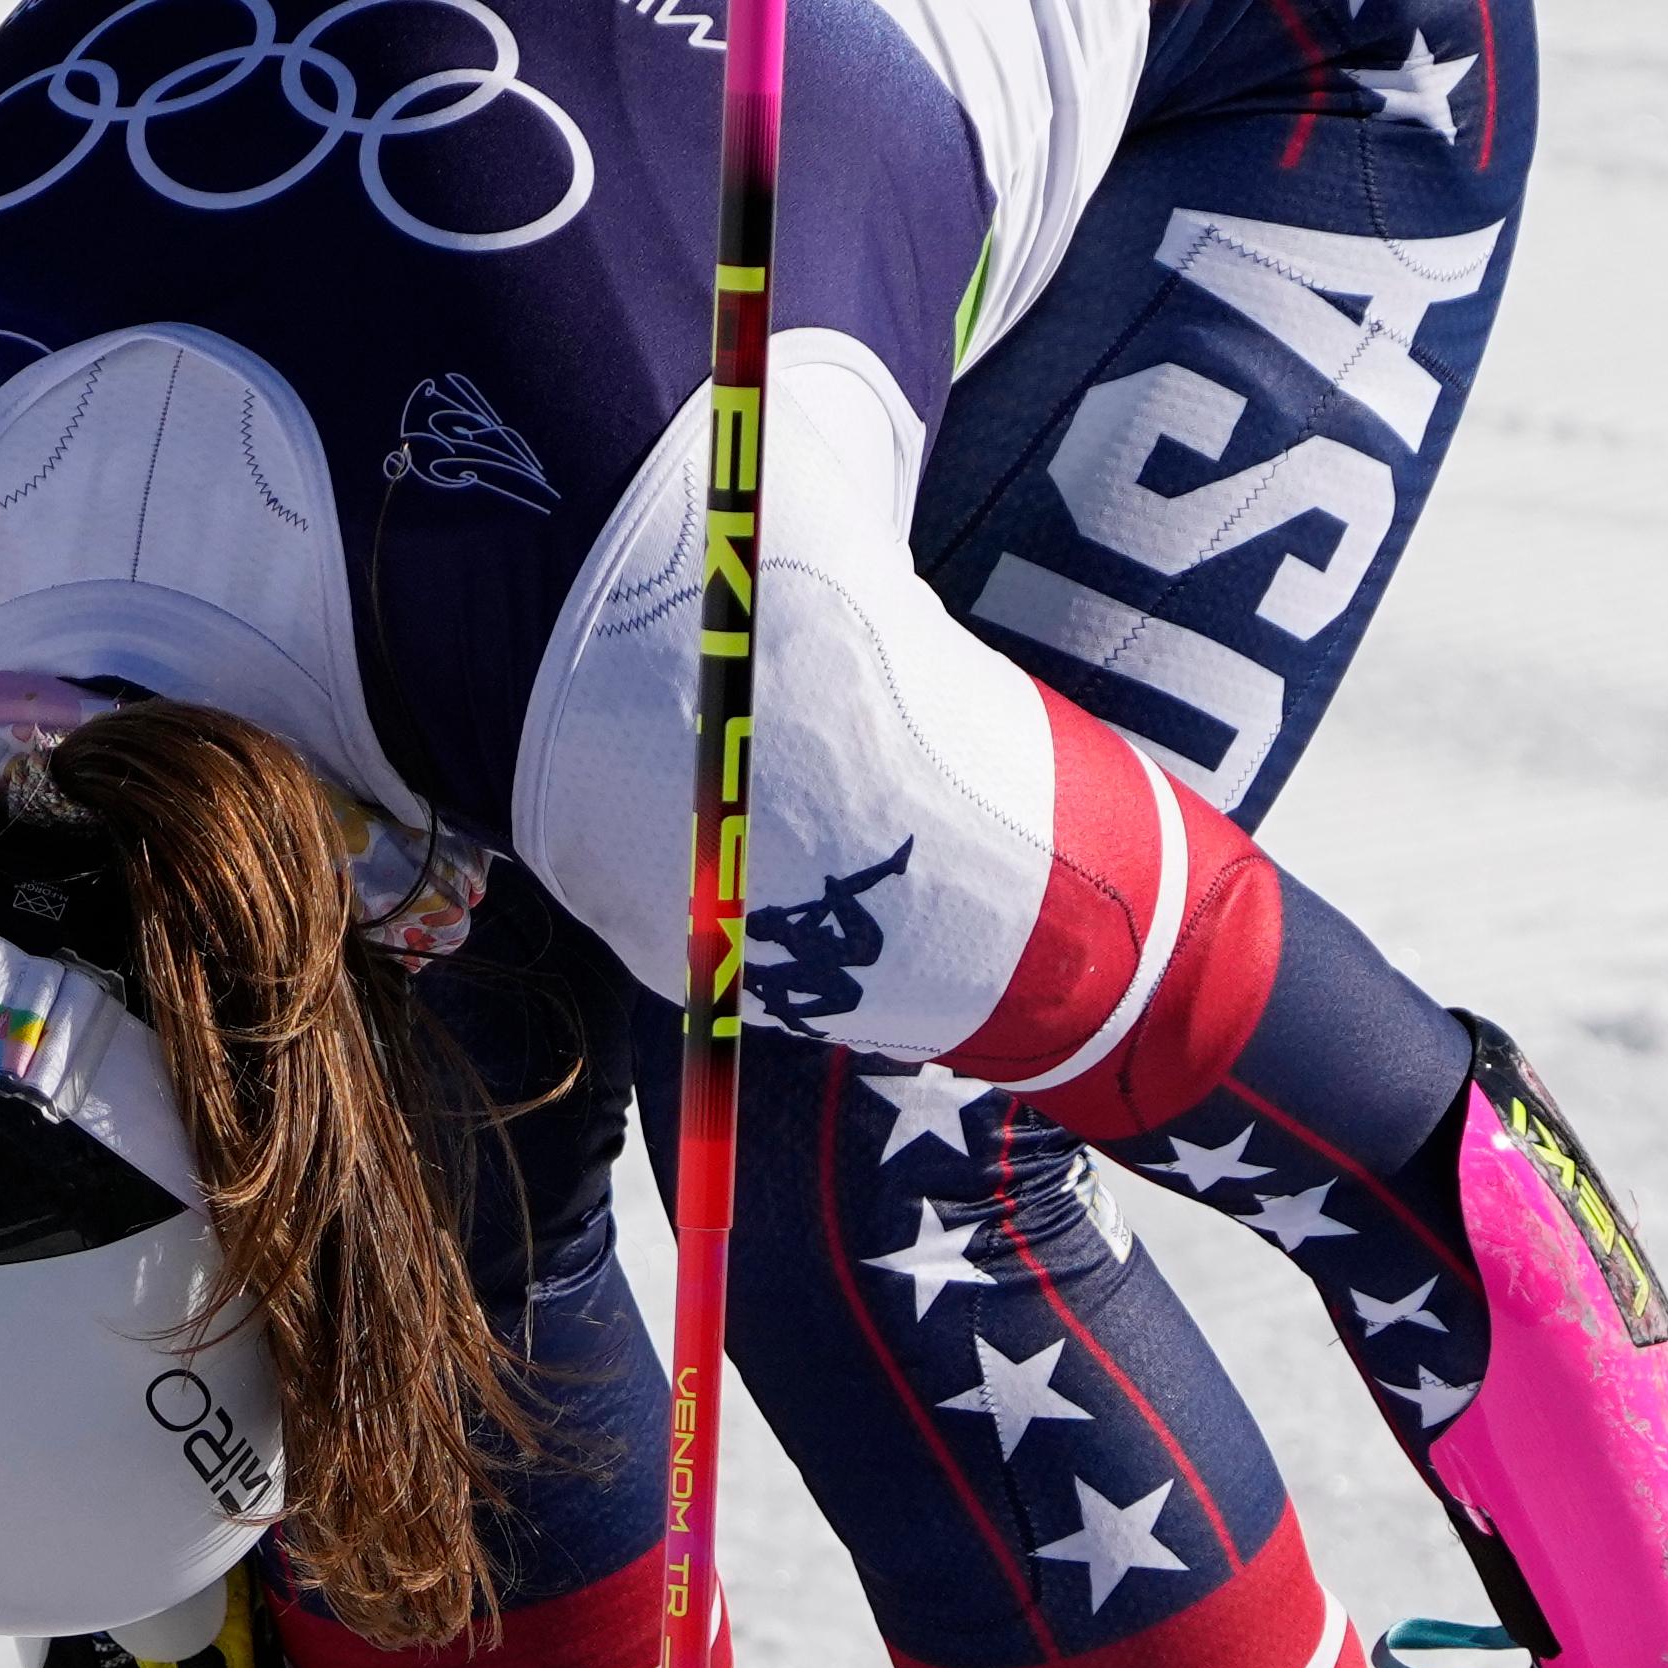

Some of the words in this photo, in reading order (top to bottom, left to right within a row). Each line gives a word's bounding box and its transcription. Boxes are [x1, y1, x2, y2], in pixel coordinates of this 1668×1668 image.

[699, 264, 765, 658] LEKI
[970, 207, 1506, 811] USA
[667, 1553, 690, 1617] TR
[670, 1367, 698, 1532] VENOM
